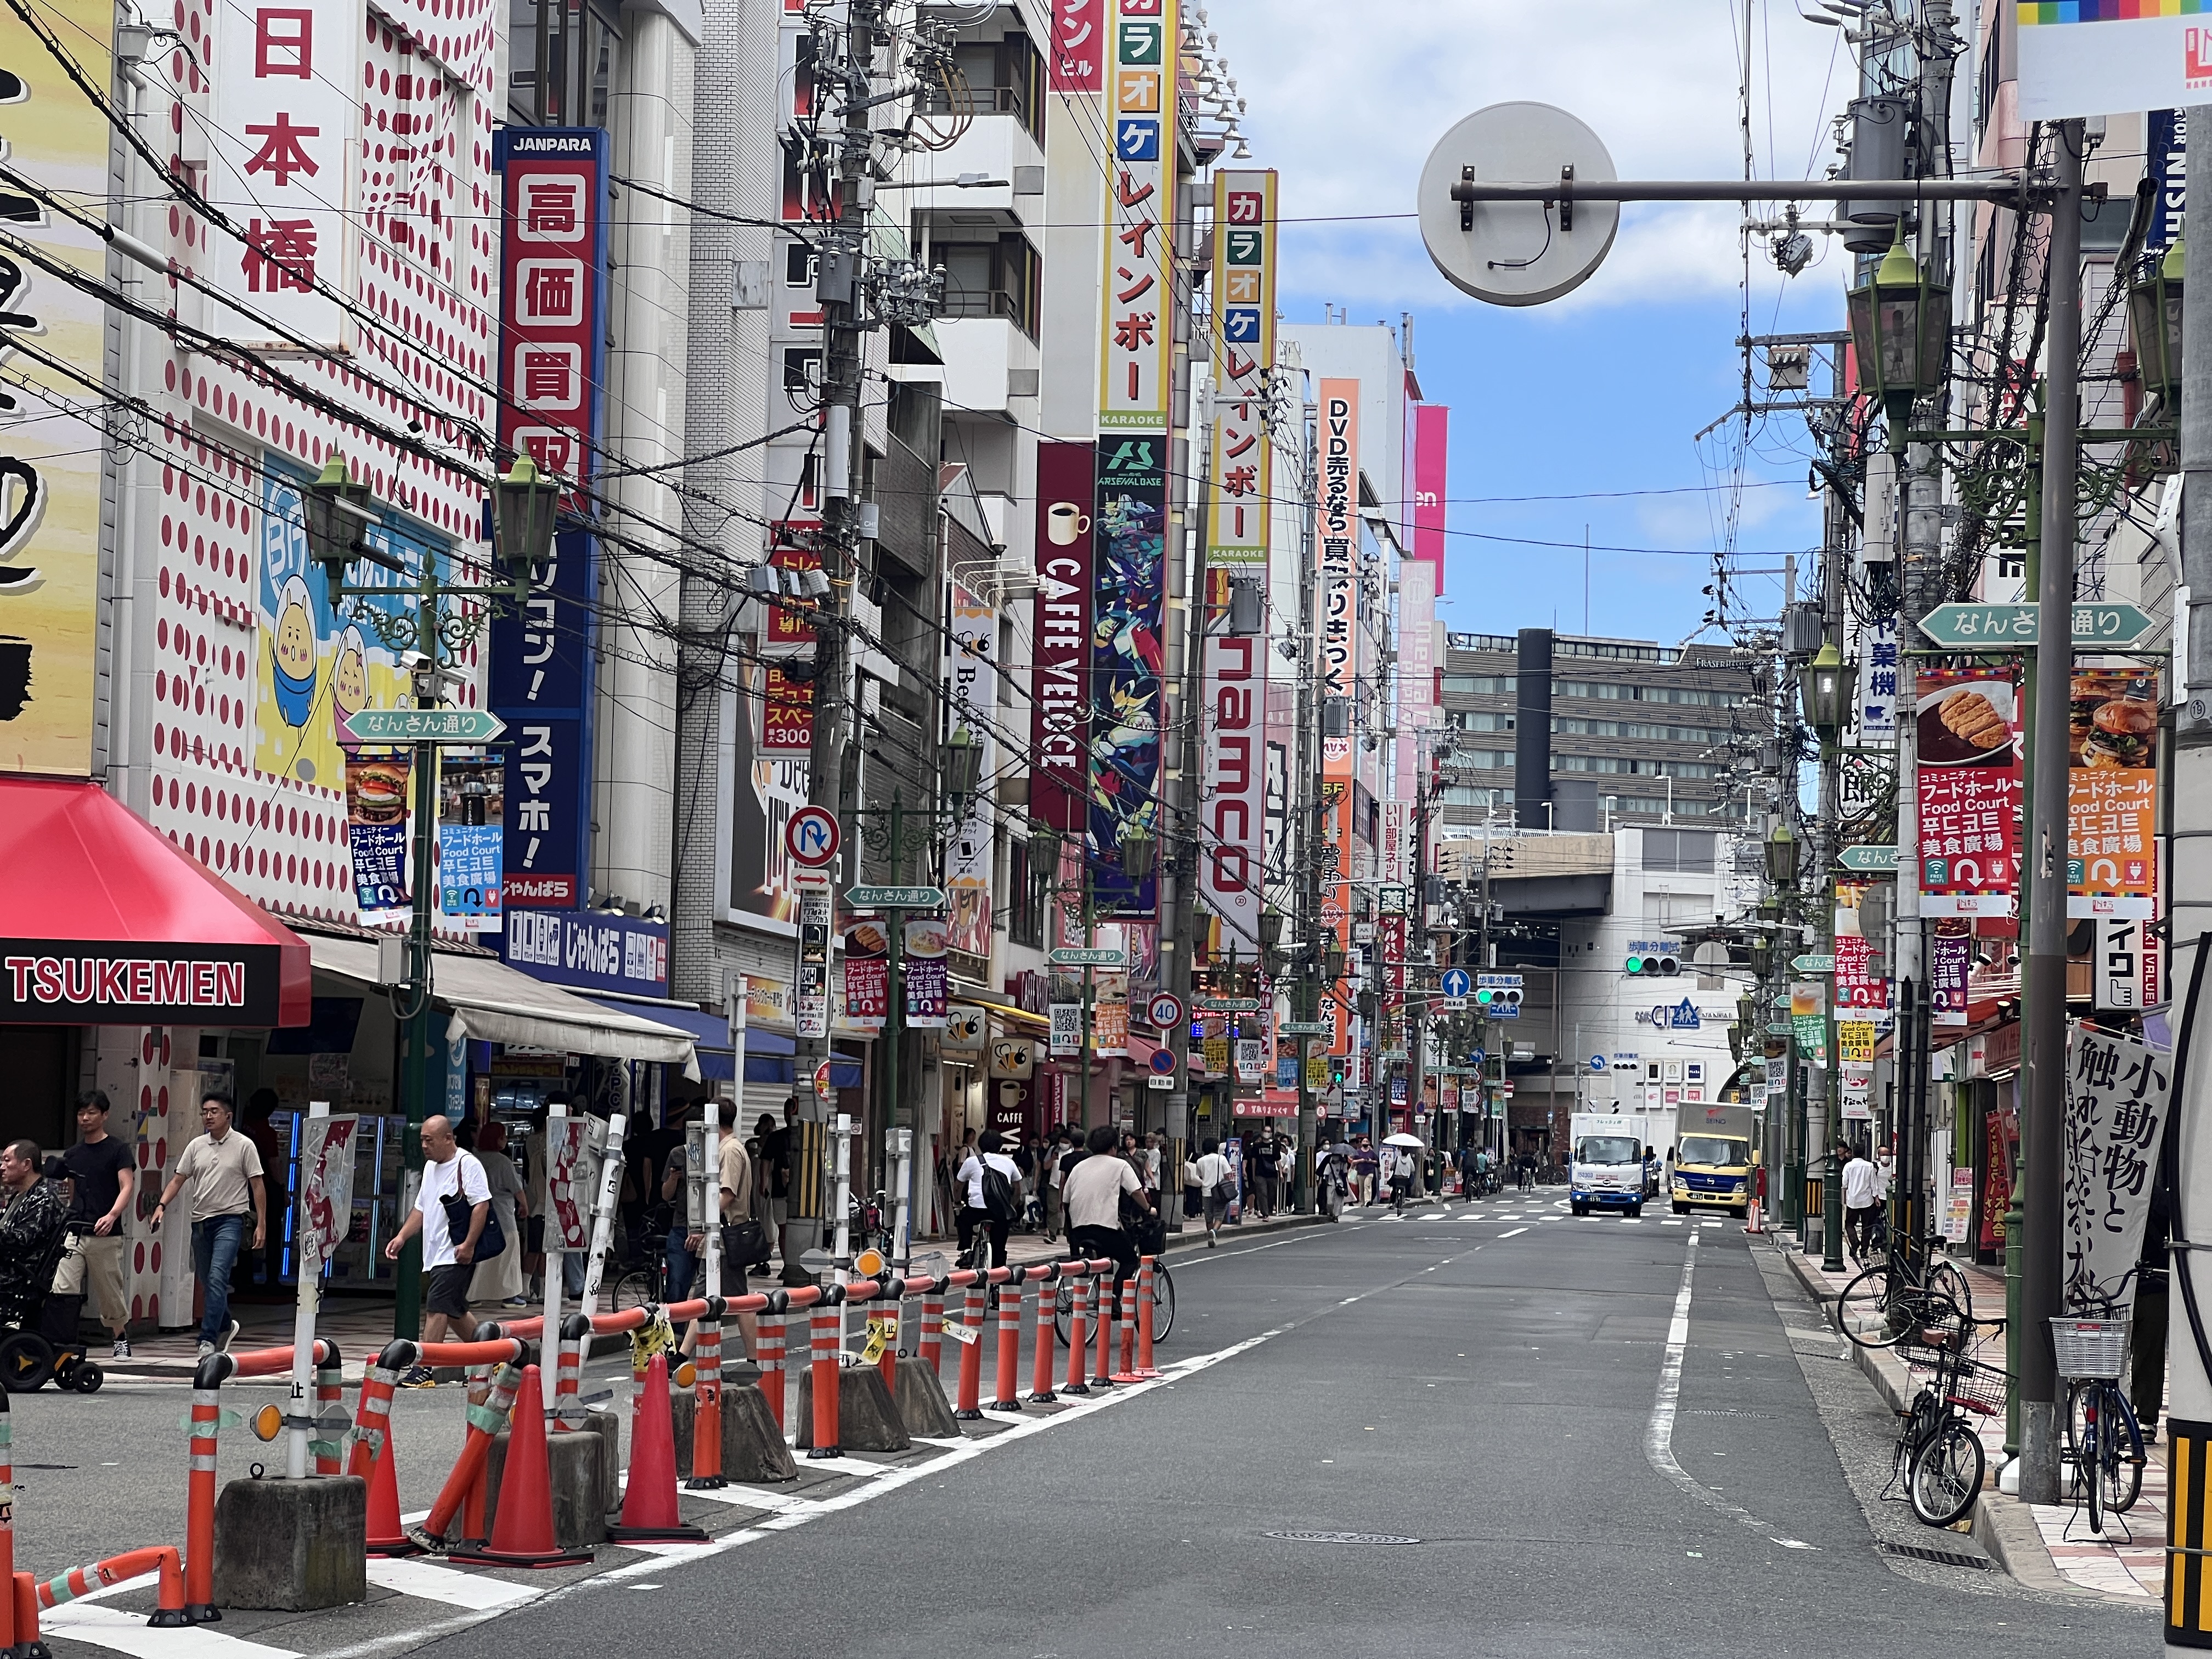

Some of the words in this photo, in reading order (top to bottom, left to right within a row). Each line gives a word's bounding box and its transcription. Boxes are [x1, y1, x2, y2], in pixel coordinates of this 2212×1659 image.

[1060, 59, 1093, 77] ビル
[241, 8, 320, 294] 日本橋
[514, 137, 591, 151] JANPARA
[1230, 195, 1256, 337] カラオケ
[1117, 171, 1155, 400] レインボー
[1101, 415, 1164, 425] KARAOKE
[1225, 350, 1257, 538] レインボー
[1326, 399, 1350, 532] DVD売るなら
[1954, 610, 2120, 635] なんさ通り
[1696, 658, 1724, 668] FRASER
[1041, 658, 1079, 768] VELOCE
[2192, 704, 2202, 714] 19
[368, 714, 477, 733] なんさん通り
[1212, 638, 1253, 893] namco
[1920, 771, 1987, 783] コミュニティー
[2071, 771, 2128, 782] ミュニティー
[1921, 777, 2012, 800] フードホール
[1922, 802, 1960, 816] Food
[1965, 796, 2010, 811] Court
[2069, 800, 2100, 815] ood
[2105, 797, 2150, 812] Court
[351, 827, 390, 835] コミュニティー
[442, 827, 487, 835] コミュニティー
[1922, 811, 2000, 836] 푸드코트
[352, 832, 405, 847] フードホール
[443, 832, 503, 848] フードホール
[1385, 804, 1397, 884] いい部屋ネット
[1922, 833, 2003, 857] 美食廣場
[353, 848, 374, 857] Food
[375, 845, 404, 856] Court
[443, 848, 469, 857] Food
[471, 845, 500, 856] Court
[1858, 850, 1898, 864] なんさ
[354, 856, 397, 872] 푸드코트
[443, 856, 494, 873] 푸드코트
[443, 871, 496, 888] 美食廣場
[502, 880, 569, 898] じゃんぱら
[859, 890, 930, 902] なんさん通り
[1381, 890, 1404, 910] 薬
[566, 921, 620, 975] じゃんぱら
[1629, 941, 1680, 953] 歩車分離式
[1837, 944, 1874, 955] フードホー
[1060, 951, 1116, 961] なんさん通り
[1804, 957, 1833, 968] なんさ
[802, 968, 815, 984] 24H
[847, 965, 887, 975] フードホール
[907, 964, 947, 974] フードホール
[1836, 963, 1868, 975] 푸드코
[848, 979, 882, 991] 푸드코트
[907, 979, 941, 991] 푸드코트
[1479, 976, 1521, 985] 歩車分離式
[2145, 956, 2155, 1005] VALUE!
[1155, 1003, 1175, 1019] 40
[1211, 1000, 1253, 1008] なんさん通り
[1792, 1018, 1825, 1026] フードホール
[2103, 1053, 2166, 1233] 小動物と
[290, 1381, 304, 1398] 止
